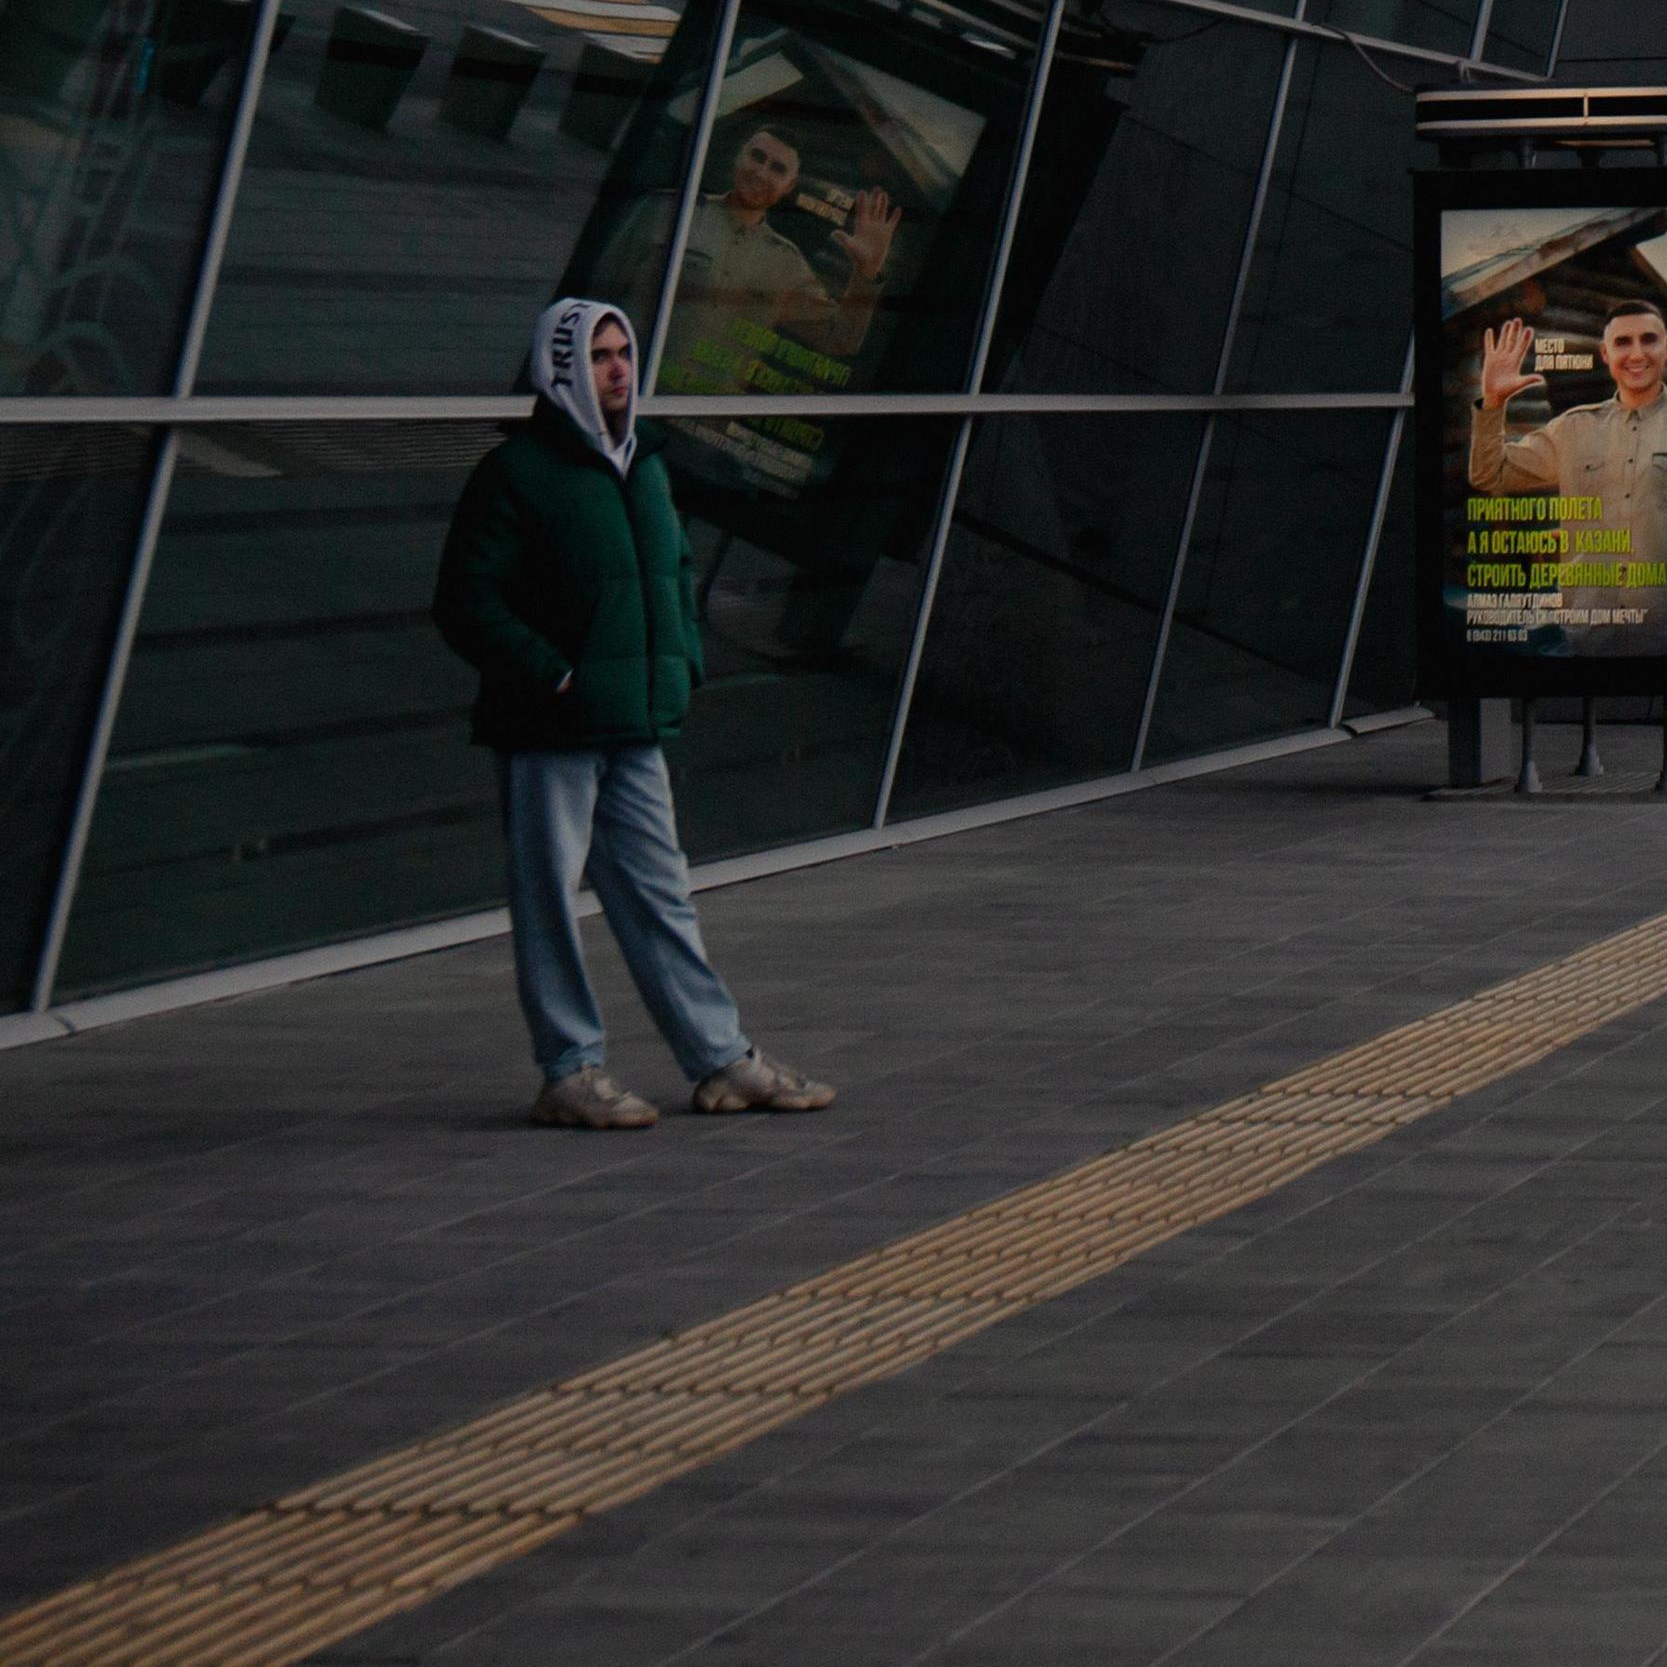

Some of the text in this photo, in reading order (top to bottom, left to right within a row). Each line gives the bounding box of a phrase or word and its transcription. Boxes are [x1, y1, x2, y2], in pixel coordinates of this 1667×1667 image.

[1467, 496, 1602, 521] ПРИЯТНОГО ПОЛЕТА
[1467, 531, 1477, 554] А
[1479, 531, 1489, 554] Я
[1491, 530, 1557, 554] ОСТАЮСЬ
[1560, 530, 1569, 553] В
[1467, 564, 1526, 587] СТРОИТЬ
[1529, 563, 1624, 590] ДЕРЕВЯННЫЕ
[1626, 562, 1666, 588] ДОМА
